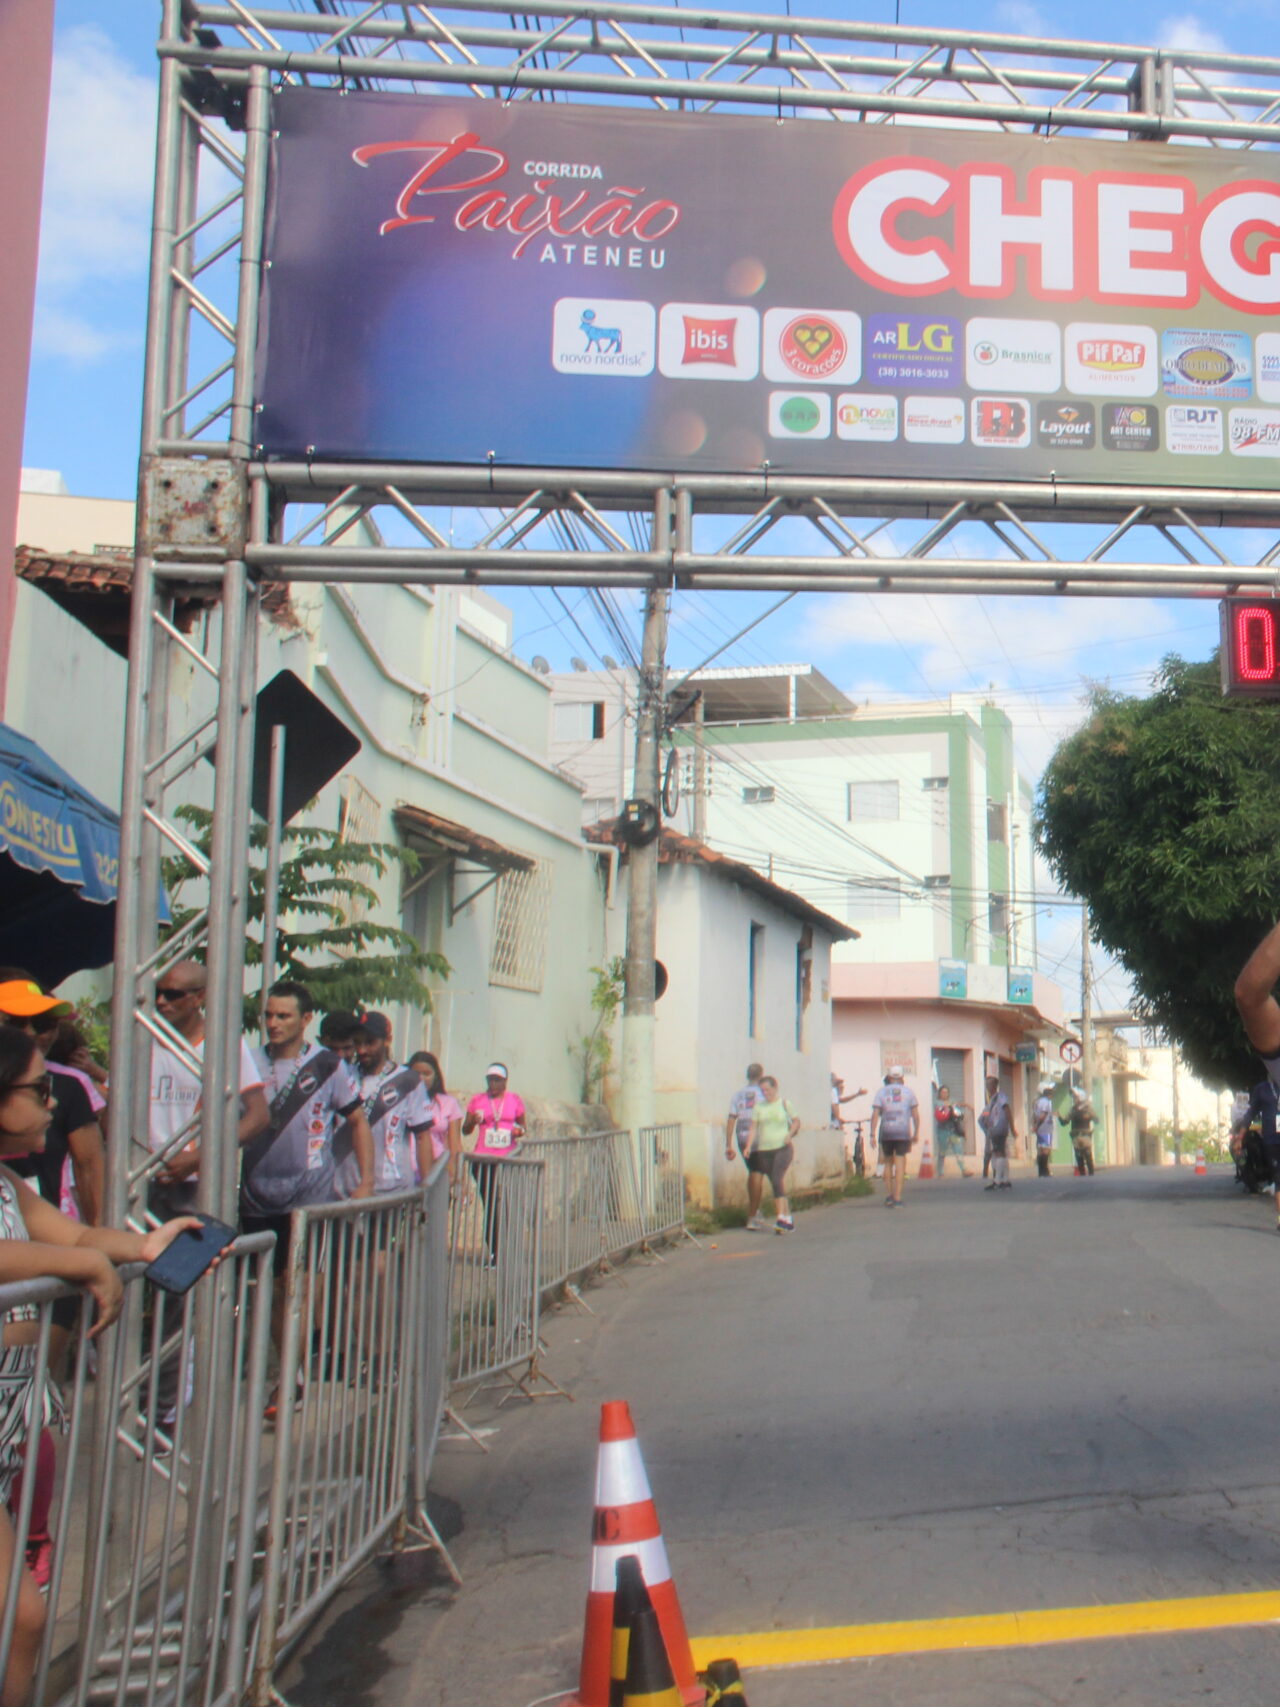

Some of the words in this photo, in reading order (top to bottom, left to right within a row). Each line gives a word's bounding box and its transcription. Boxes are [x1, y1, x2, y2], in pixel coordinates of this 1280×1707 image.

[523, 160, 603, 180] CORRIDA
[351, 132, 682, 260] Paixão
[540, 242, 667, 270] ATENEU
[690, 329, 729, 350] ibis
[560, 353, 592, 365] novo
[595, 351, 642, 367] nordisk
[1082, 343, 1108, 361] Pif
[1112, 343, 1142, 364] Paf
[1040, 420, 1091, 437] Layout
